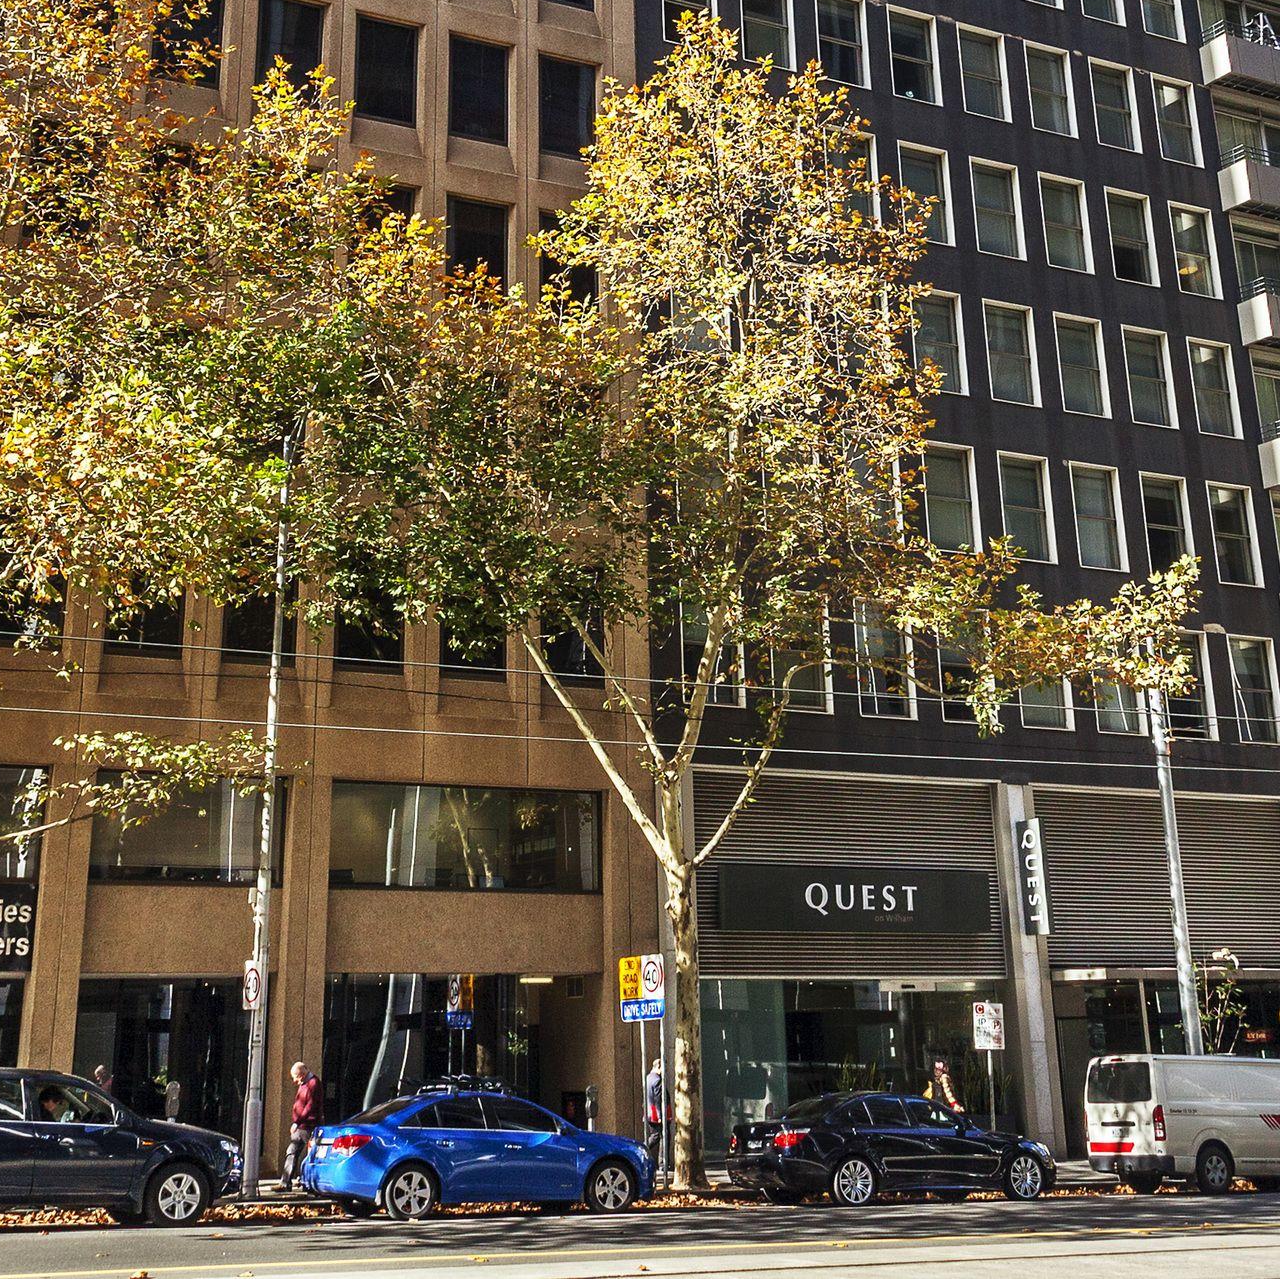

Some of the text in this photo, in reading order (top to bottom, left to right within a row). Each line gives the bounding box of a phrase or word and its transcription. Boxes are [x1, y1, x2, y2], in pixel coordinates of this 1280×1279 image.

[1020, 828, 1045, 925] QUEST
[804, 882, 918, 916] QUEST
[245, 976, 258, 993] 40
[645, 969, 658, 984] 40
[641, 1001, 663, 1016] SAFELY
